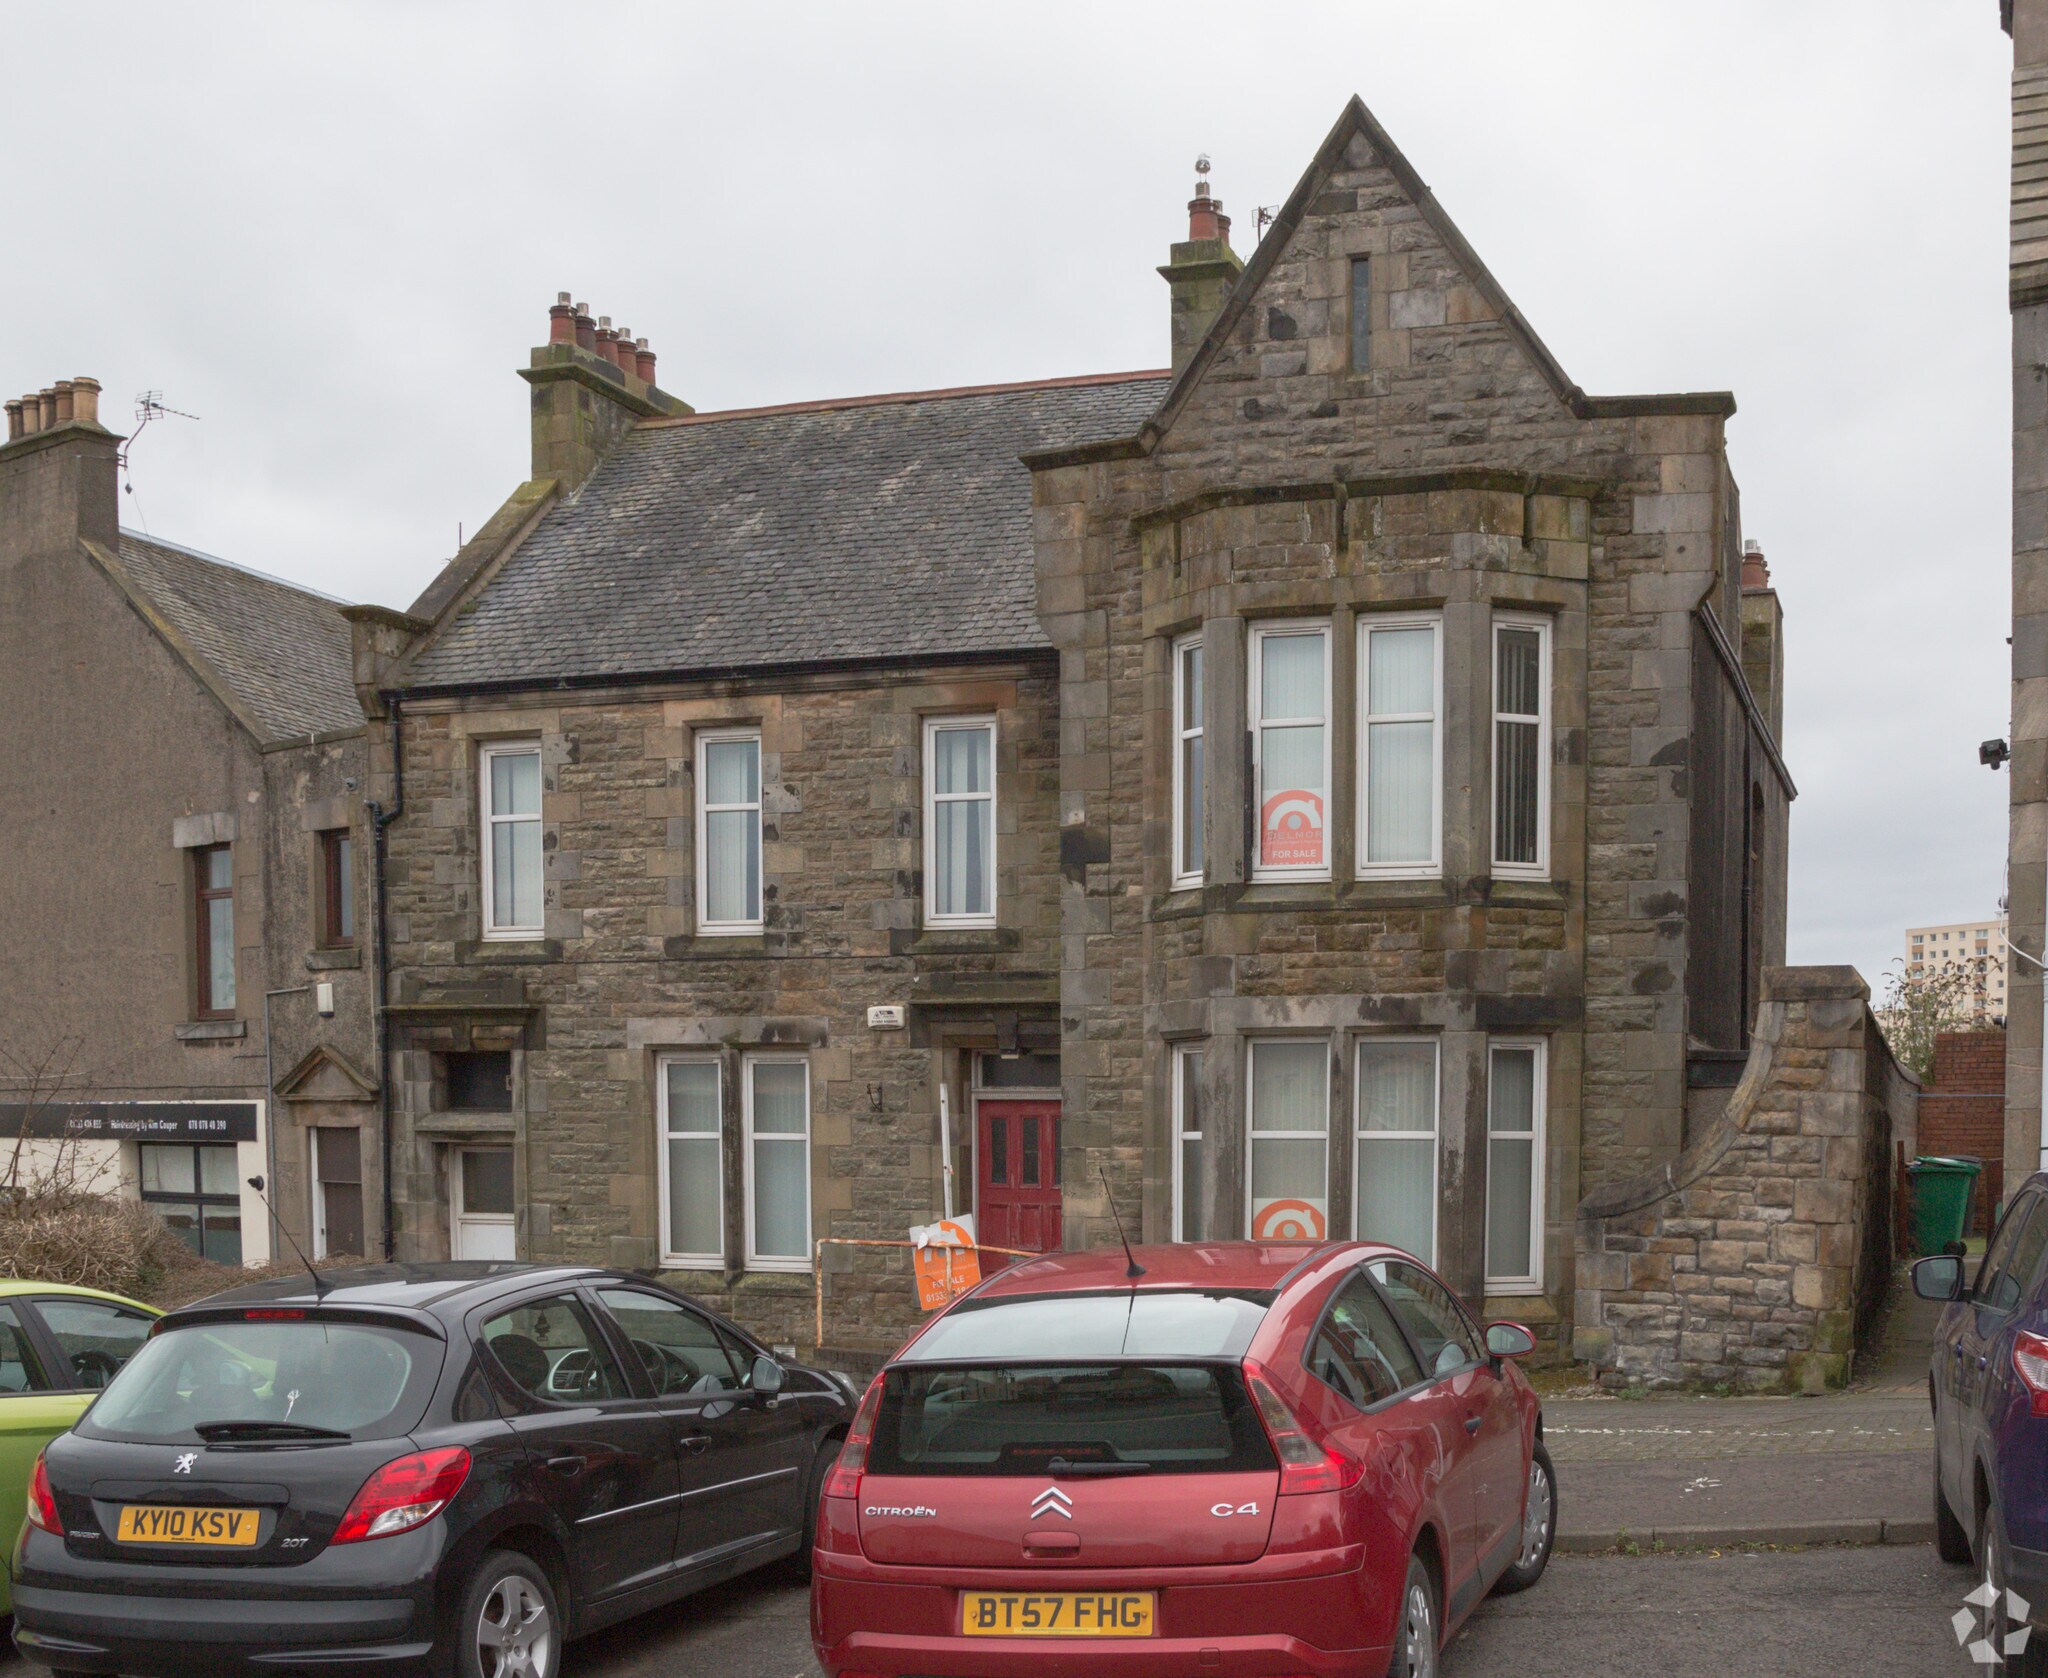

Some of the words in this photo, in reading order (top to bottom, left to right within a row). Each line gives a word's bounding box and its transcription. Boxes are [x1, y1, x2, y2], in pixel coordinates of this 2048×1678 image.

[1272, 850, 1291, 858] FOR
[1293, 849, 1316, 858] SALE
[141, 1119, 147, 1132] by
[865, 1505, 937, 1517] CITROËN
[1210, 1502, 1260, 1518] C4
[132, 1509, 185, 1536] KY10
[191, 1511, 242, 1539] KSV
[280, 1538, 309, 1548] 207
[978, 1597, 1063, 1628] BT57
[1074, 1597, 1141, 1628] FHG
